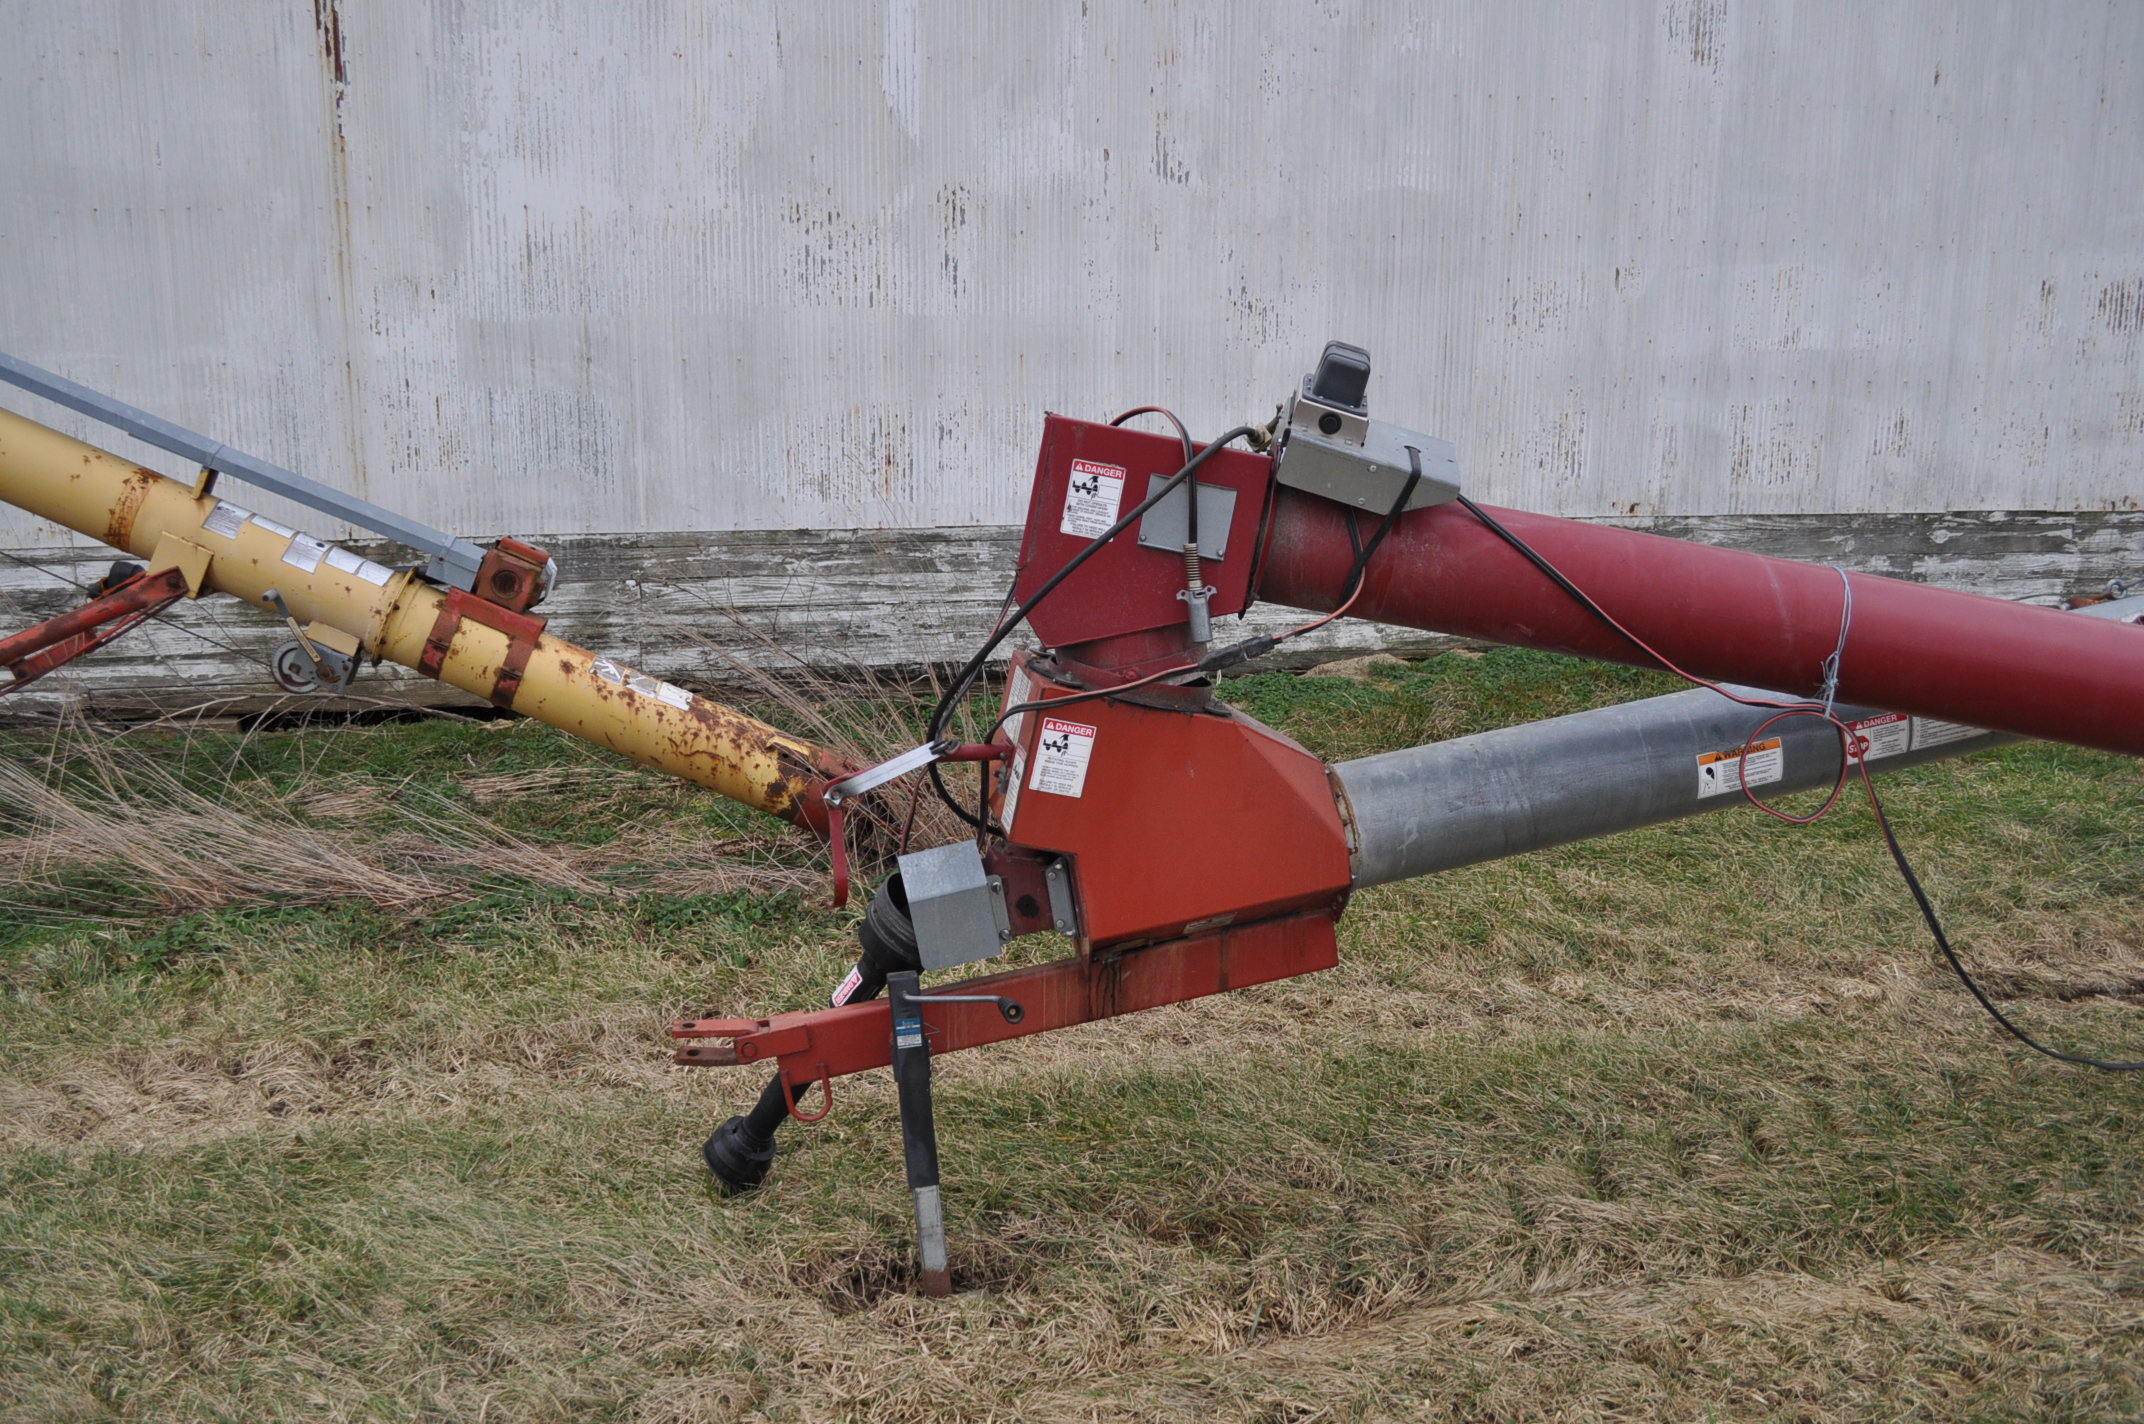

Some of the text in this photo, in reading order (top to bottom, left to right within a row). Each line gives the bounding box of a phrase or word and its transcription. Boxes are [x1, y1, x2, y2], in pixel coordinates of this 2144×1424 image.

[1084, 464, 1122, 478] DANGER
[1863, 714, 1898, 727] DANGER
[1055, 722, 1092, 736] DANGER
[1724, 743, 1766, 759] WARING
